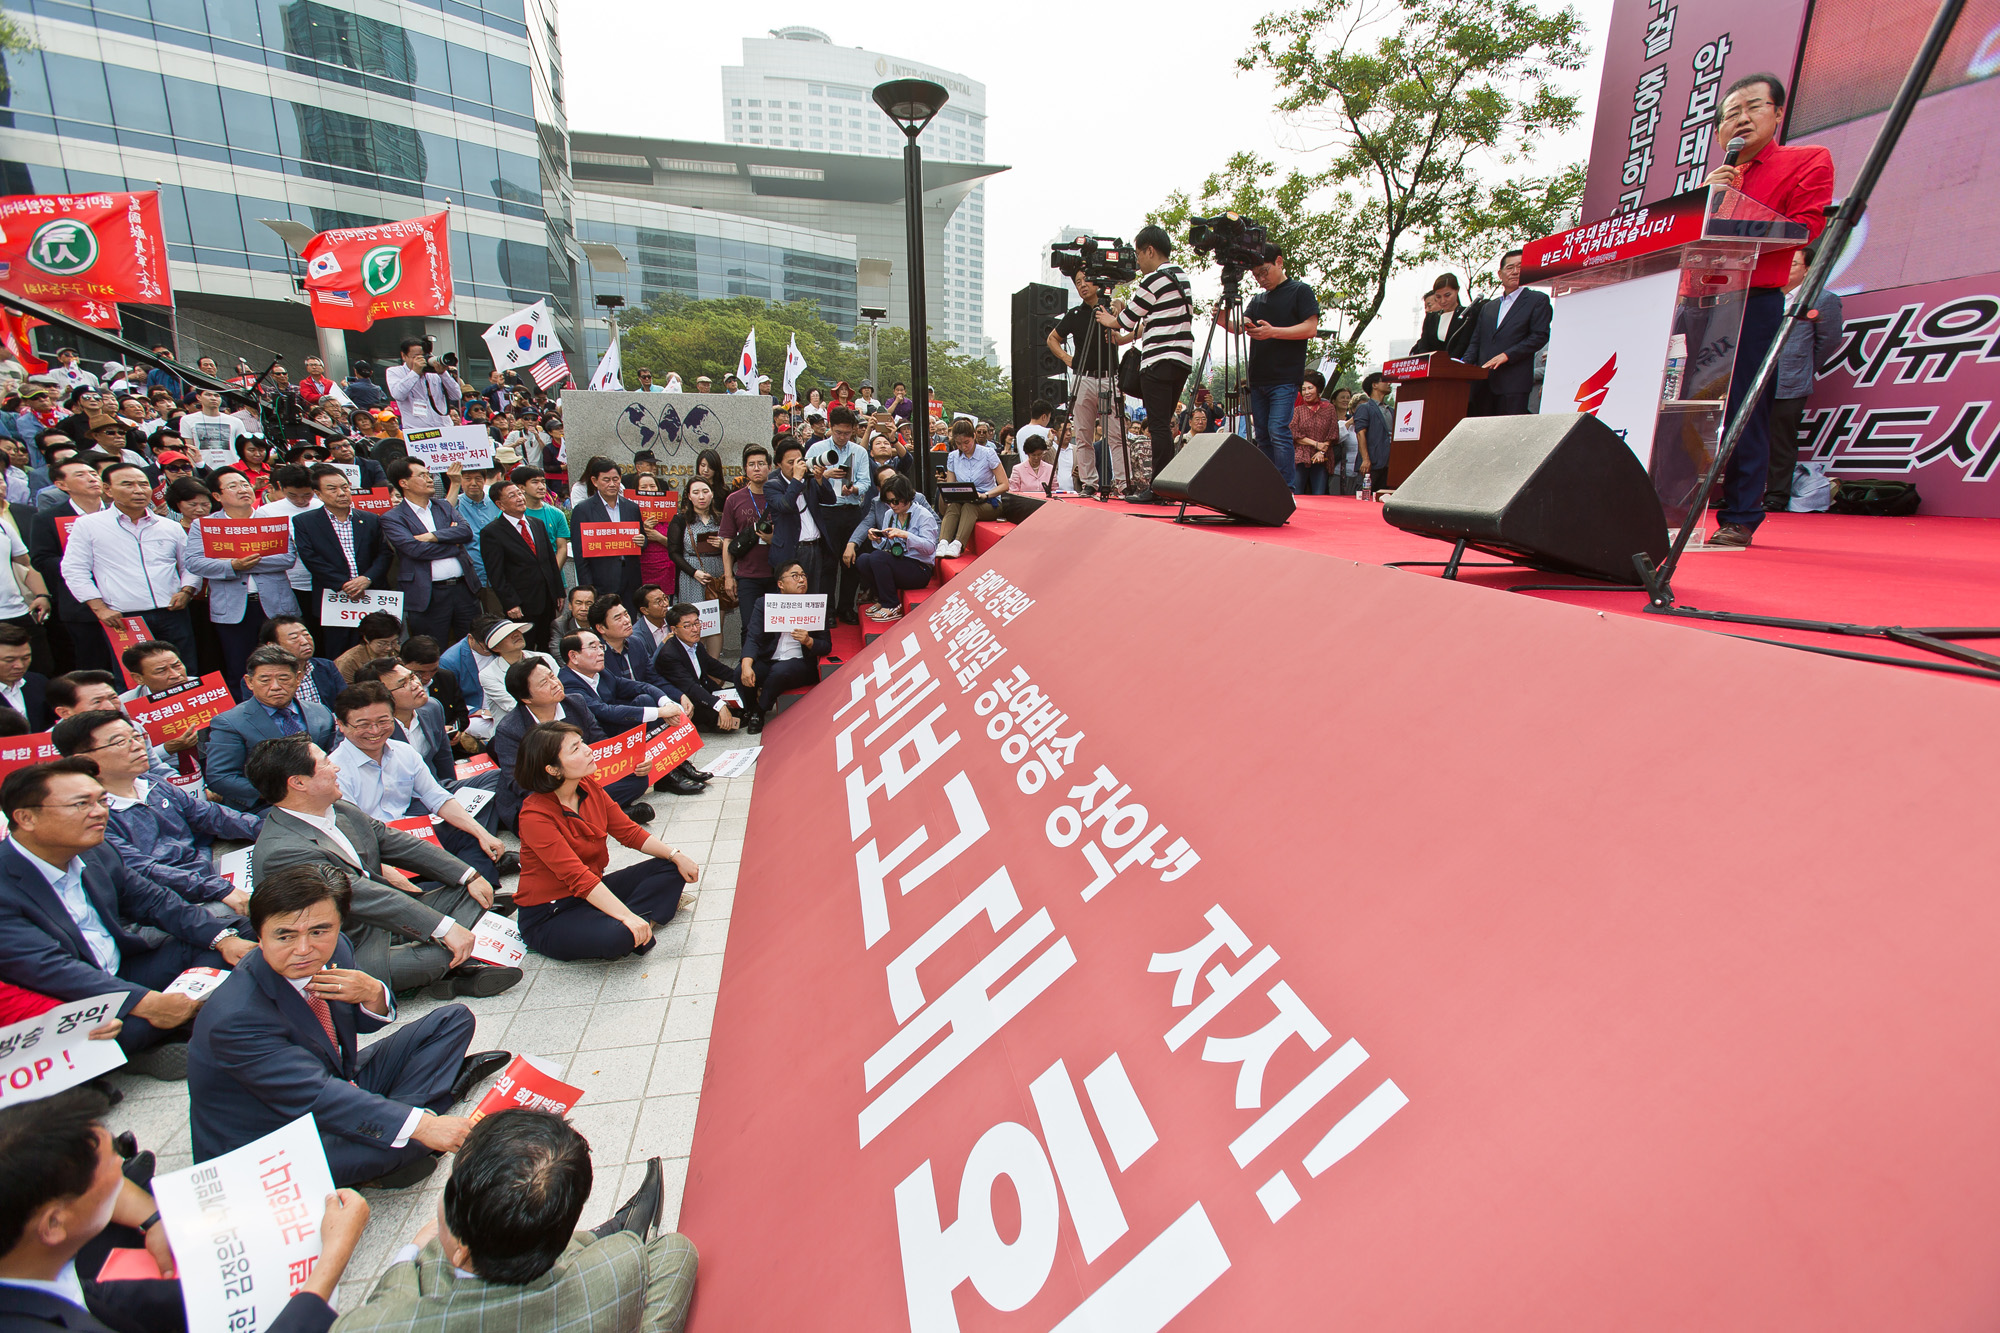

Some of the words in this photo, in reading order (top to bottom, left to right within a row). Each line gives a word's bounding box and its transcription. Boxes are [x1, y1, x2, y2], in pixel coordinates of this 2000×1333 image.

[892, 64, 971, 96] INTER-CONTINENTAL
[1541, 246, 1574, 267] 반드시
[1578, 215, 1676, 256] 지켜내겠습니다!
[1563, 208, 1649, 247] 자유대한민국을
[469, 449, 489, 460] 저지
[656, 465, 694, 475] TRADE
[723, 465, 743, 475] TER
[203, 526, 221, 534] 북한
[224, 526, 257, 535] 김정은의
[260, 523, 288, 533] 핵개발을
[596, 528, 617, 536] 김정은의
[212, 541, 234, 551] 강력
[240, 539, 283, 552] 규탄한다!
[588, 541, 601, 550] 강력
[605, 541, 636, 550] 규탄한다!
[377, 595, 398, 606] 장악
[966, 569, 1009, 603] 문재인
[341, 610, 373, 620] STO
[770, 616, 785, 625] 강력
[789, 616, 820, 625] 규탄한다!
[985, 584, 1036, 627] 정권의
[944, 617, 1008, 694] 핵인질,
[135, 702, 185, 727] 文정권의
[187, 687, 228, 707] 구걸안보
[161, 707, 219, 735] 즉각중단!
[644, 741, 667, 761] 정권의
[666, 722, 695, 745] 구걸안보
[974, 664, 1085, 795] 공영방송
[2, 747, 31, 760] 북한
[592, 742, 623, 762] 영방송
[626, 731, 643, 749] 장악
[654, 743, 691, 773] 즉각중단!
[1045, 764, 1202, 903] 장악”
[478, 936, 504, 952] 강력
[832, 632, 1232, 1333] 국민보고대회
[57, 1003, 109, 1034] 장악
[1147, 902, 1410, 1225] 저지!
[259, 1149, 315, 1245] 규탄한다!
[211, 1227, 254, 1300] 김정은의
[289, 1255, 319, 1297] 력
[228, 1305, 257, 1333] 한
